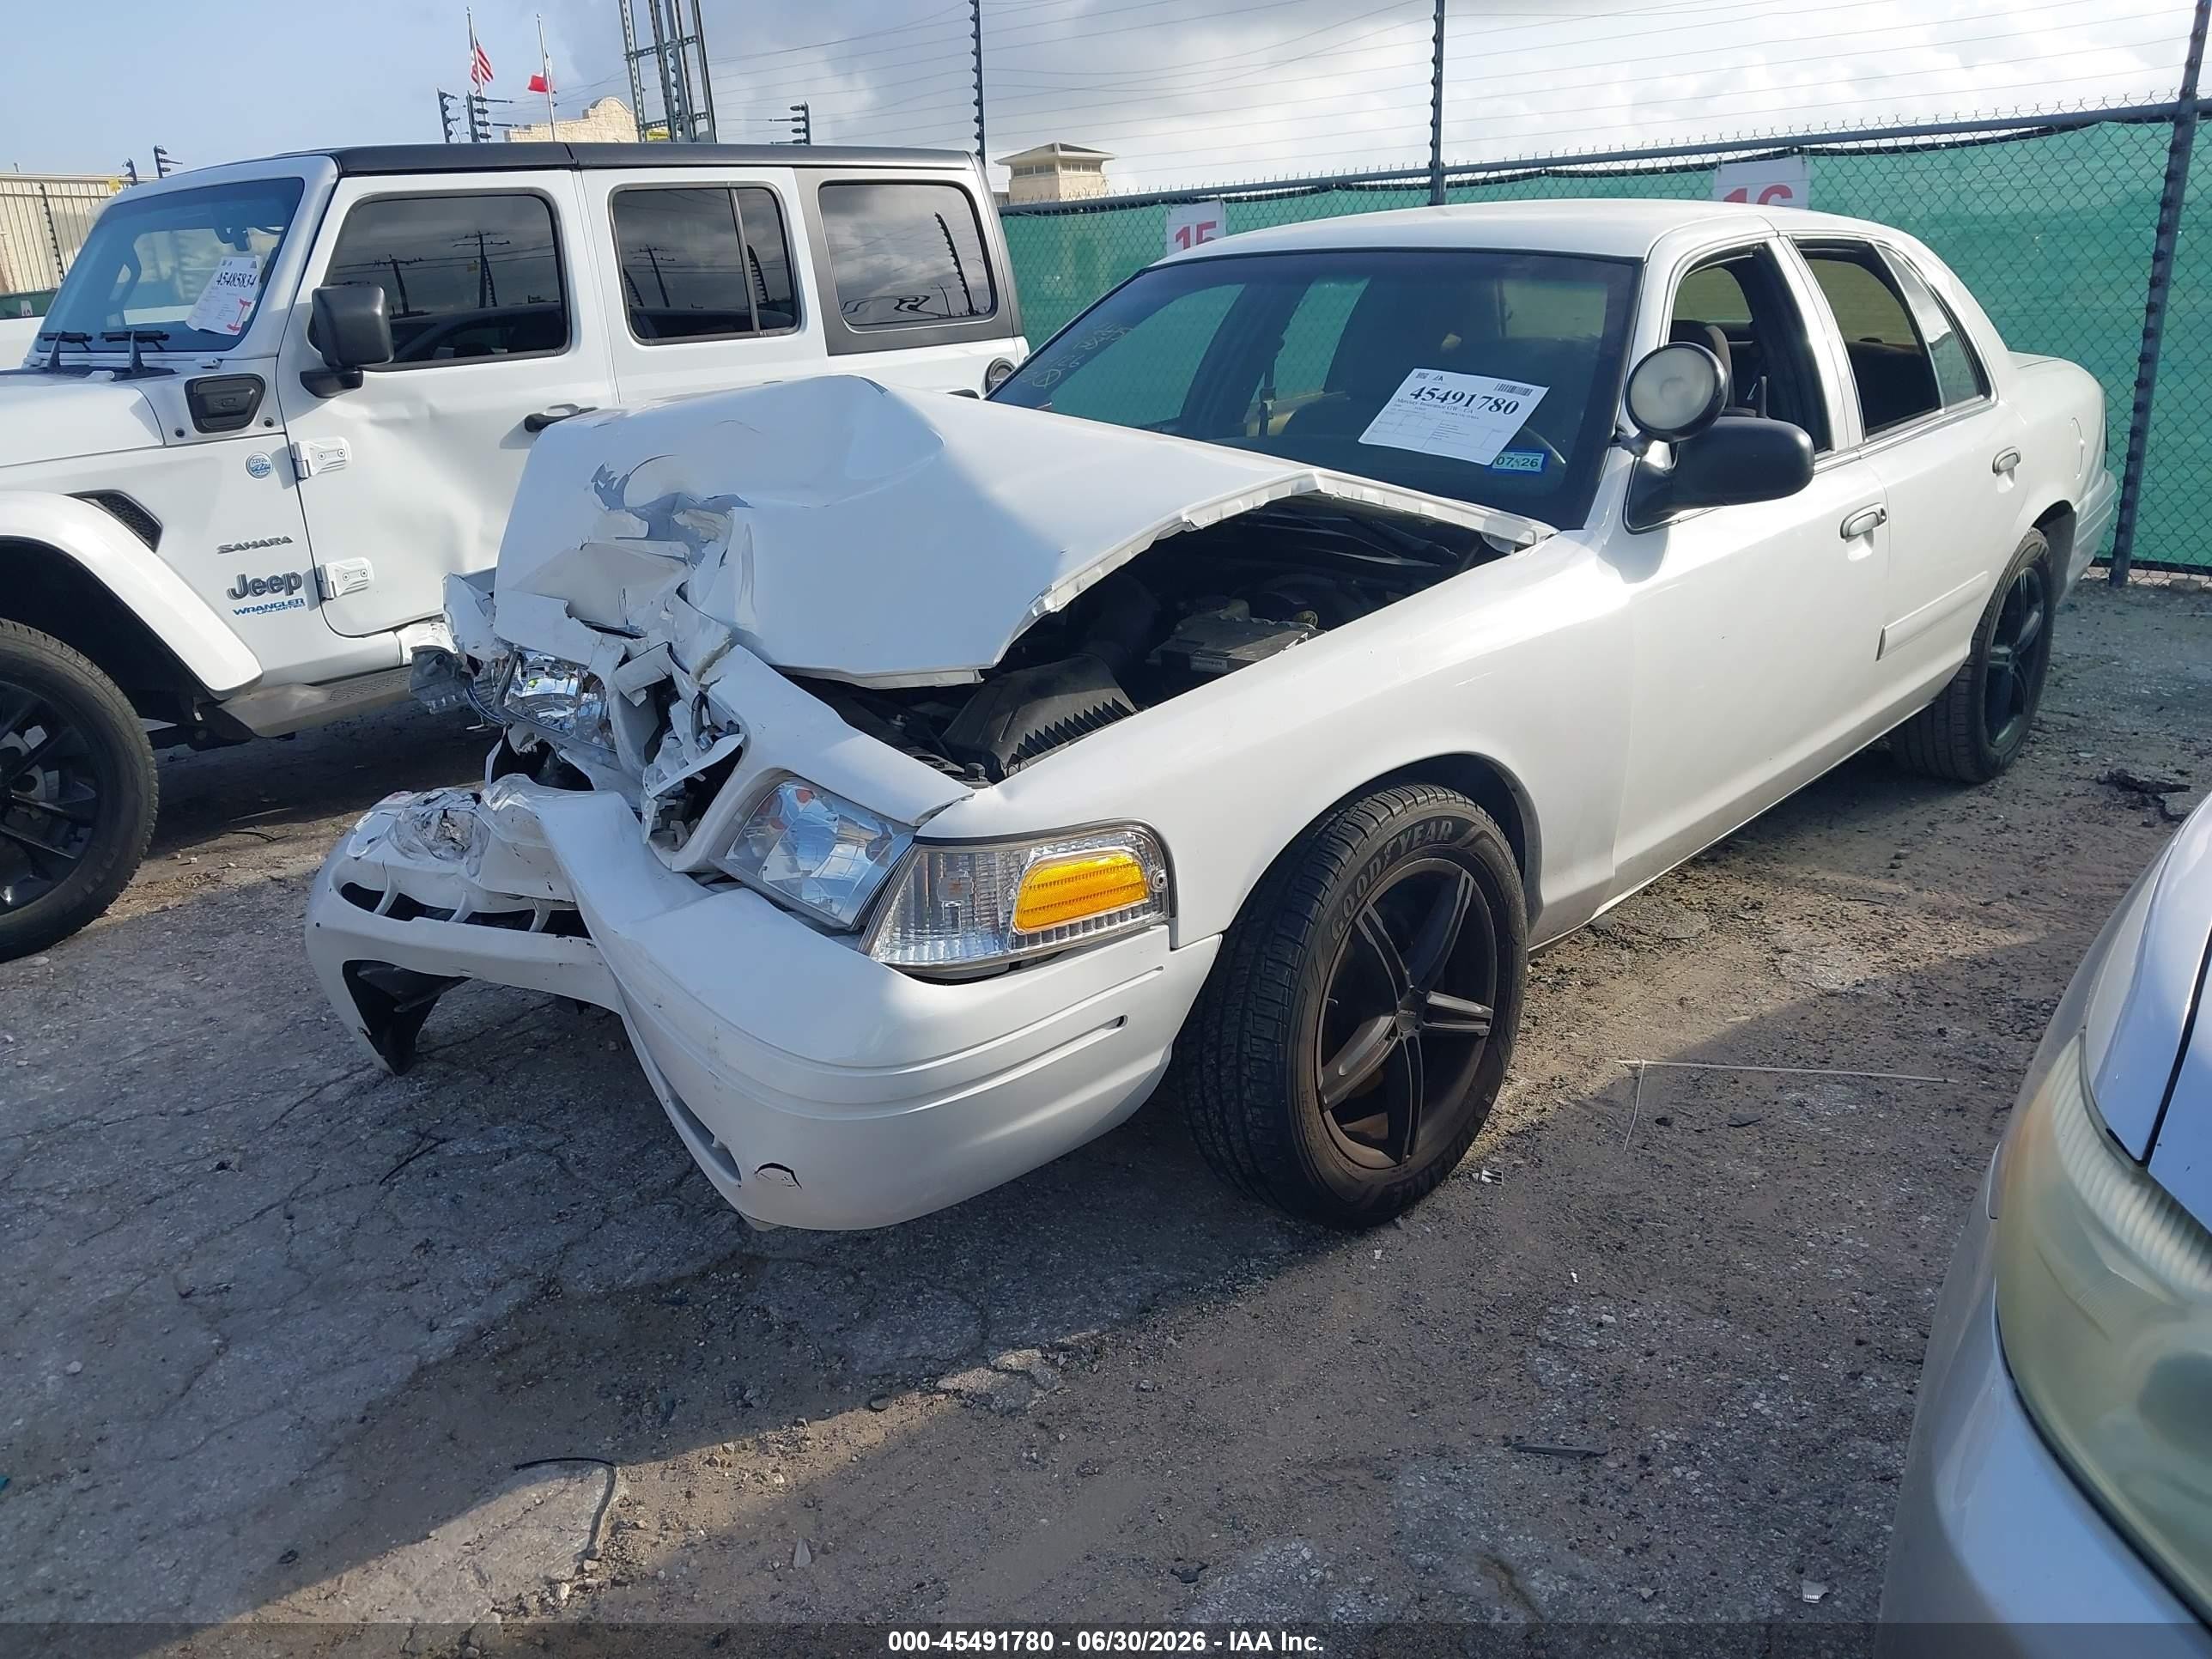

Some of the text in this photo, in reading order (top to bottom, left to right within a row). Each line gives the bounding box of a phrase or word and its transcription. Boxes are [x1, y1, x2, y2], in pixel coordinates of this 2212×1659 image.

[216, 271, 258, 288] 45485834
[1409, 386, 1520, 415] 45491780
[1496, 456, 1539, 468] 07 26
[216, 535, 294, 554] SAHARA
[226, 571, 303, 600] Jeep
[233, 598, 305, 615] WRANGLER
[257, 603, 306, 615] UNLIMITED
[1332, 819, 1453, 941] GOODYEAR
